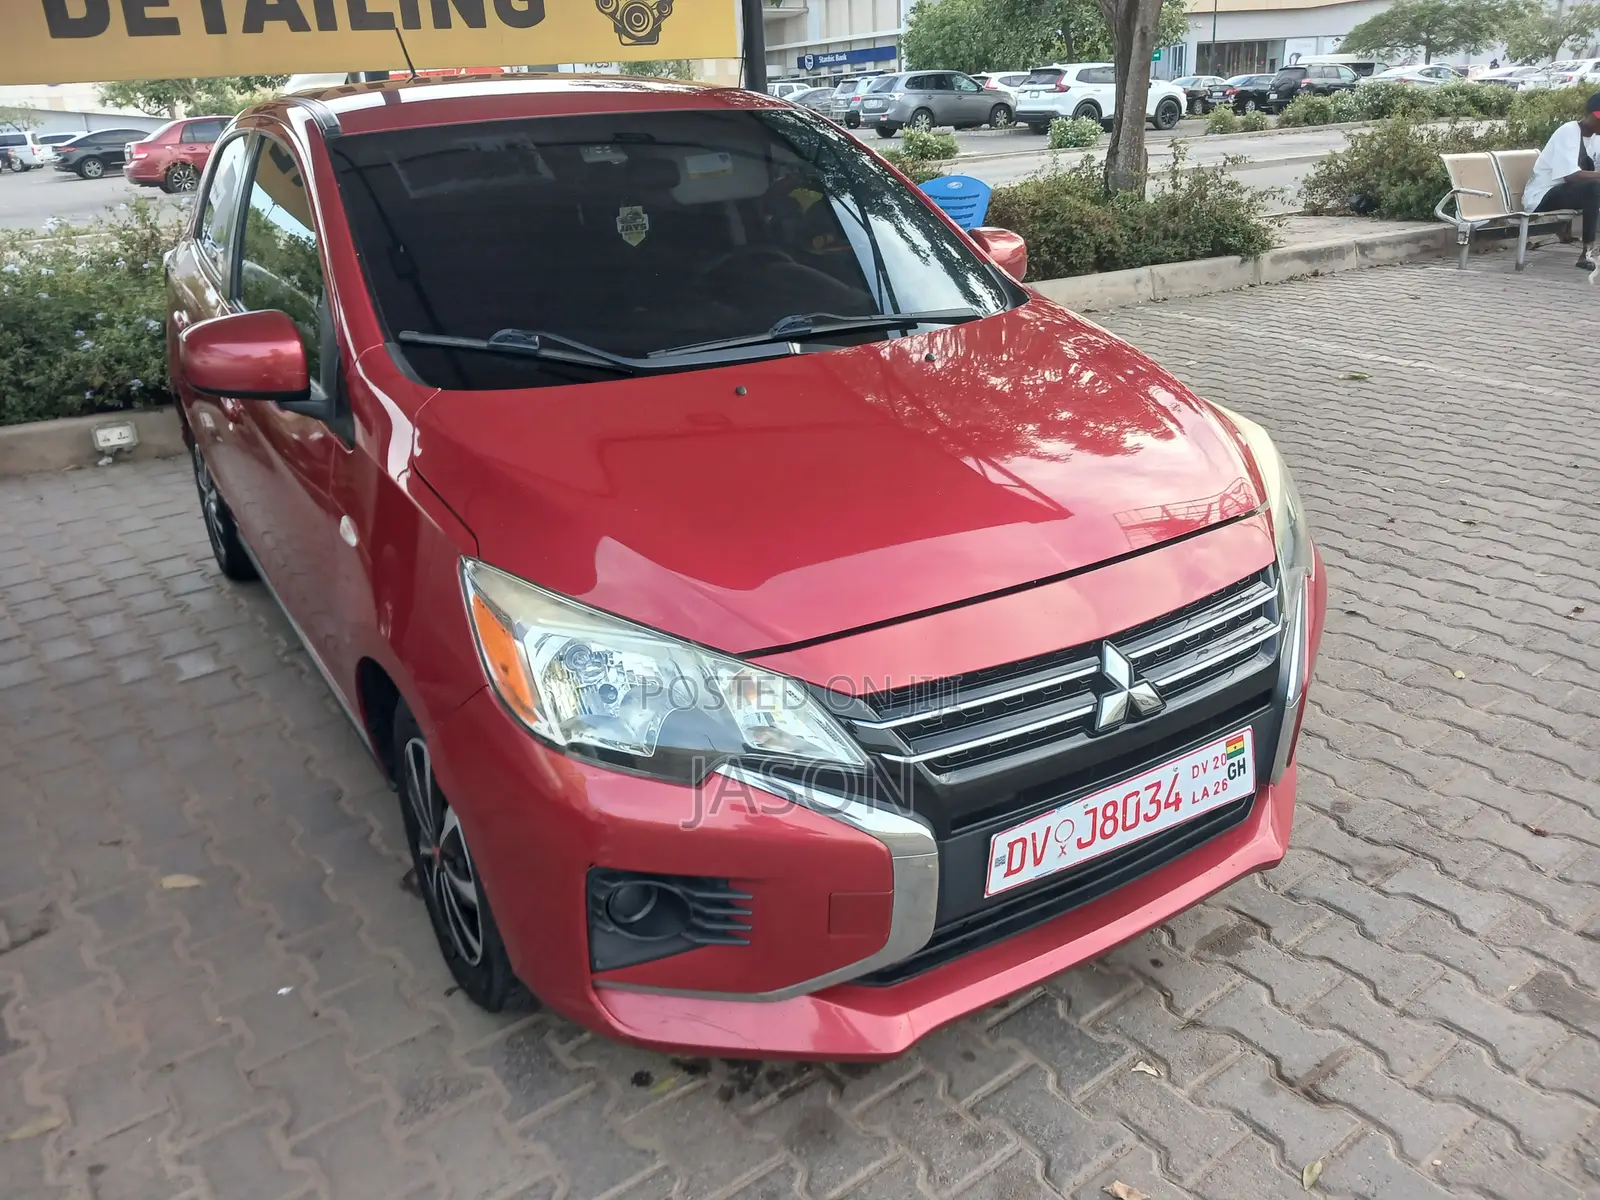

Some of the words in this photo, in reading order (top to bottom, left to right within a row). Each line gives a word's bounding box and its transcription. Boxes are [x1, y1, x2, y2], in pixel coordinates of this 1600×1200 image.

[835, 53, 848, 62] Bank
[1192, 759, 1209, 780] DV
[1212, 752, 1227, 770] 20
[1227, 757, 1247, 781] GH
[1191, 785, 1210, 805] LA
[1213, 777, 1228, 796] 26
[1003, 825, 1052, 878] DV
[1076, 773, 1183, 850] J8034
